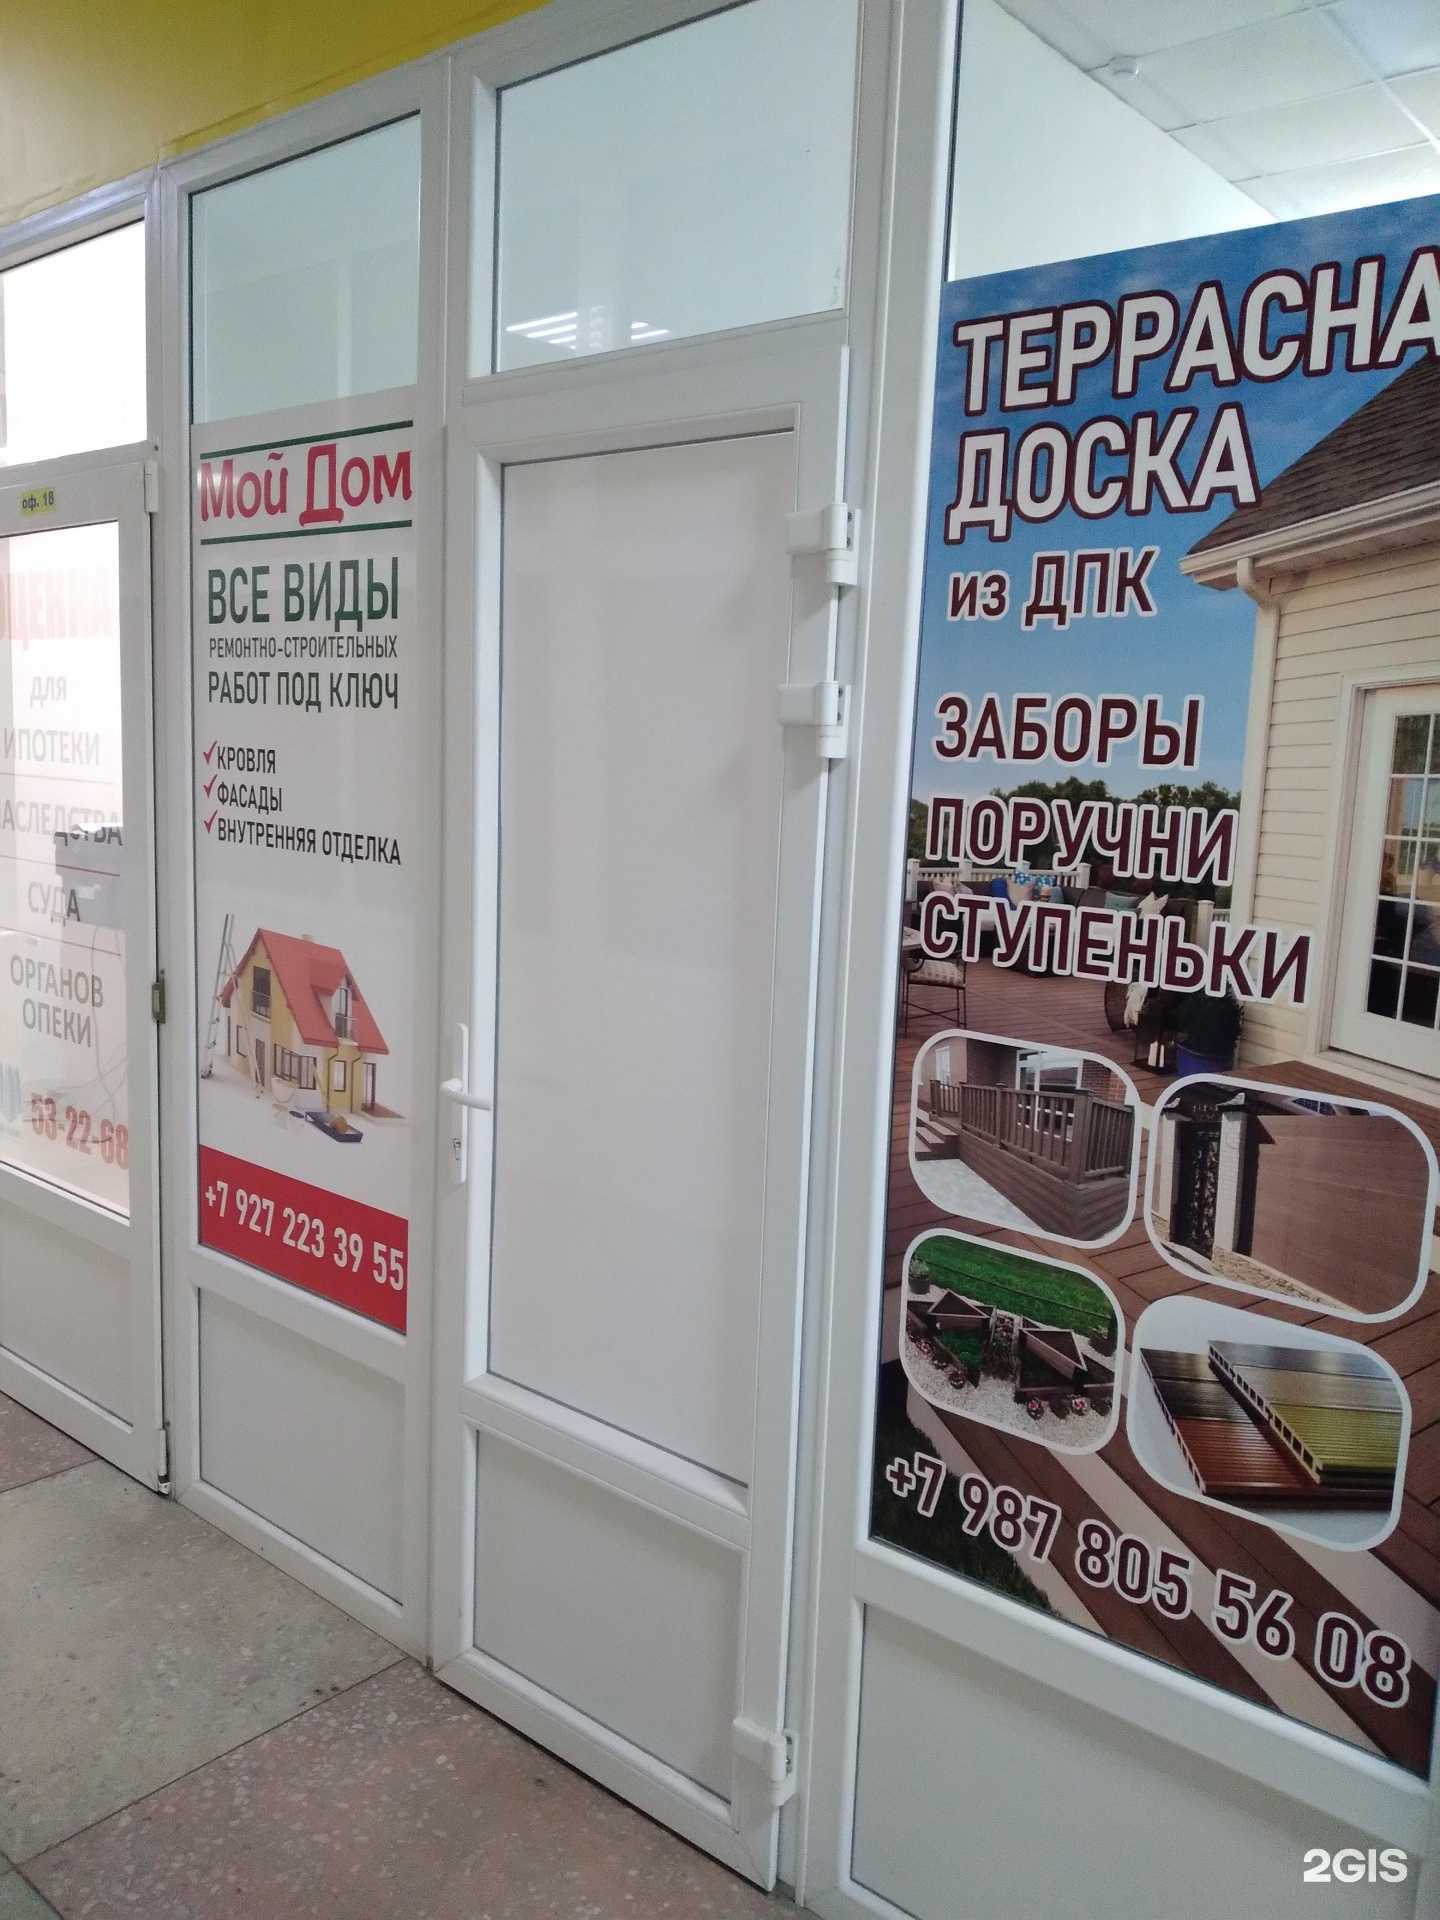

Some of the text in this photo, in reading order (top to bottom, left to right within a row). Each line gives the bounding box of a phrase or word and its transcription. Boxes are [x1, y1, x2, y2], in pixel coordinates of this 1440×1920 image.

[43, 490, 54, 506] 18
[200, 443, 412, 527] Мой Дом
[944, 402, 1261, 544] ДОСКА
[208, 556, 398, 632] ВСЕ ВИДЫ
[1022, 546, 1158, 630] ДПК
[209, 635, 398, 658] РЕМОНТНО-СТРОИТЕЛЬНЫХ
[208, 671, 398, 713] РАБОТ ПОД КЛЮЧ
[4, 727, 100, 766] ИПОТЕКИ
[935, 693, 1203, 770] ЗАБОРЫ
[217, 746, 276, 774] КРОВЛЯ
[217, 782, 282, 815] ФАСАДЫ
[218, 818, 401, 866] ВНУТРЕННЯЯ ОТДЕЛКА
[926, 796, 1239, 886] ПОРУЧНИ
[28, 881, 80, 926] СУДА
[920, 890, 1315, 1008] СТУПЕНЬКИ
[10, 954, 104, 1009] ОРГАНОВ
[22, 998, 92, 1048] ОПЕКИ
[205, 1180, 404, 1290] +7 927 223 39 55
[886, 1452, 1412, 1708] +7 987 805 56 08
